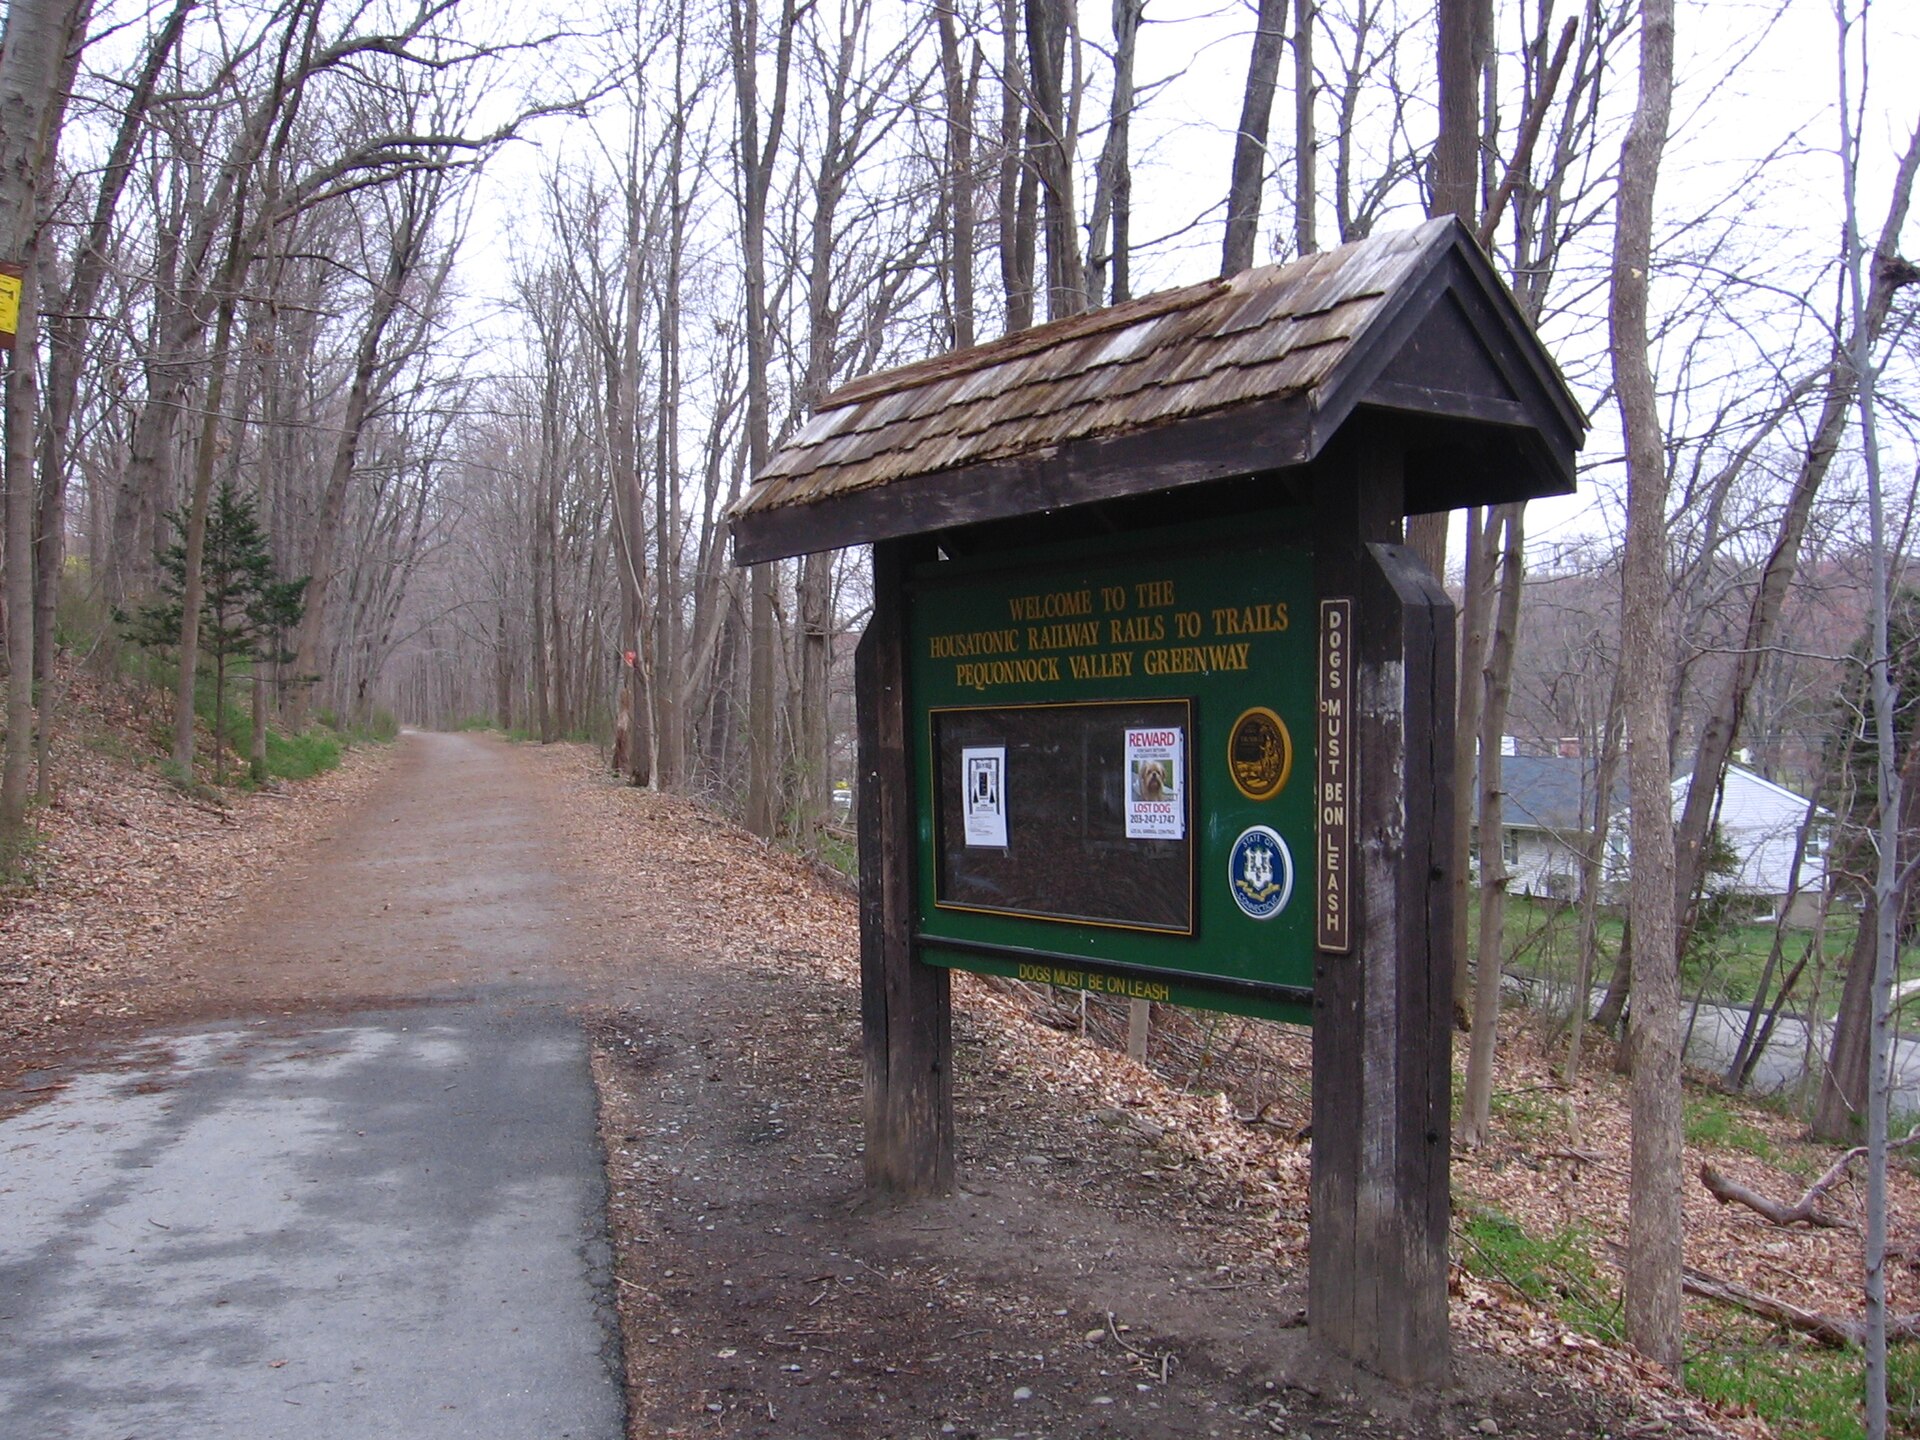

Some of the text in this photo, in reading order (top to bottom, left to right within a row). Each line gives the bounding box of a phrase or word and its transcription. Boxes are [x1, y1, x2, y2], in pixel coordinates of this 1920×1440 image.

[1009, 580, 1175, 621] WELCOME TO THE
[929, 603, 1289, 659] HOUSATONIC RAILWAY RAILS TO TRAILS
[955, 643, 1251, 691] PEQUONNOCK VALLEY GREENWAY
[1129, 731, 1175, 748] REWARD
[1324, 610, 1344, 932] DOGS MUST BE ON LEASH
[1134, 803, 1171, 814] LOST DOG
[1242, 834, 1260, 848] STATE
[1018, 963, 1169, 1001] DOGS MUST BE ON LEASH
